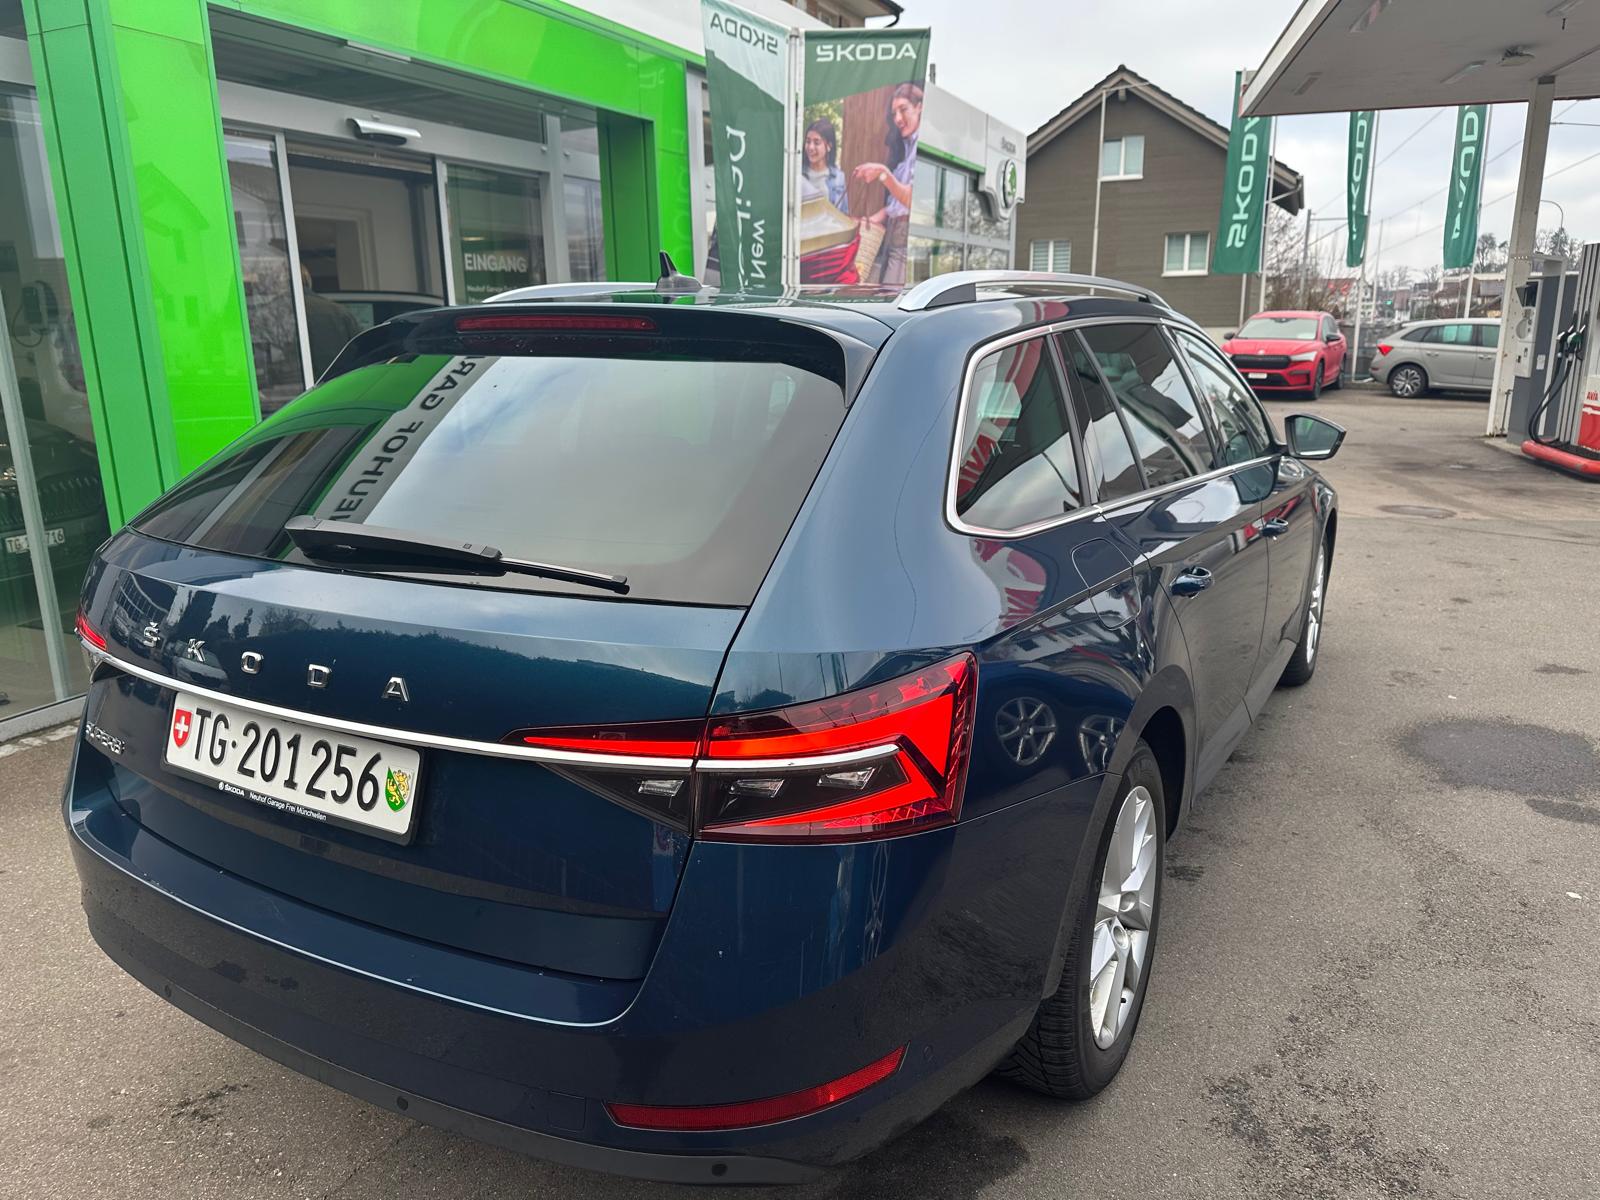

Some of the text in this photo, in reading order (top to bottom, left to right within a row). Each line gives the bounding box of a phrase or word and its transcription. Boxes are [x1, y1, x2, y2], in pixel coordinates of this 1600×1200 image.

[464, 253, 528, 273] EINGANG
[249, 792, 267, 804] Neuhof
[267, 797, 286, 810] Garage
[285, 803, 296, 812] Frei
